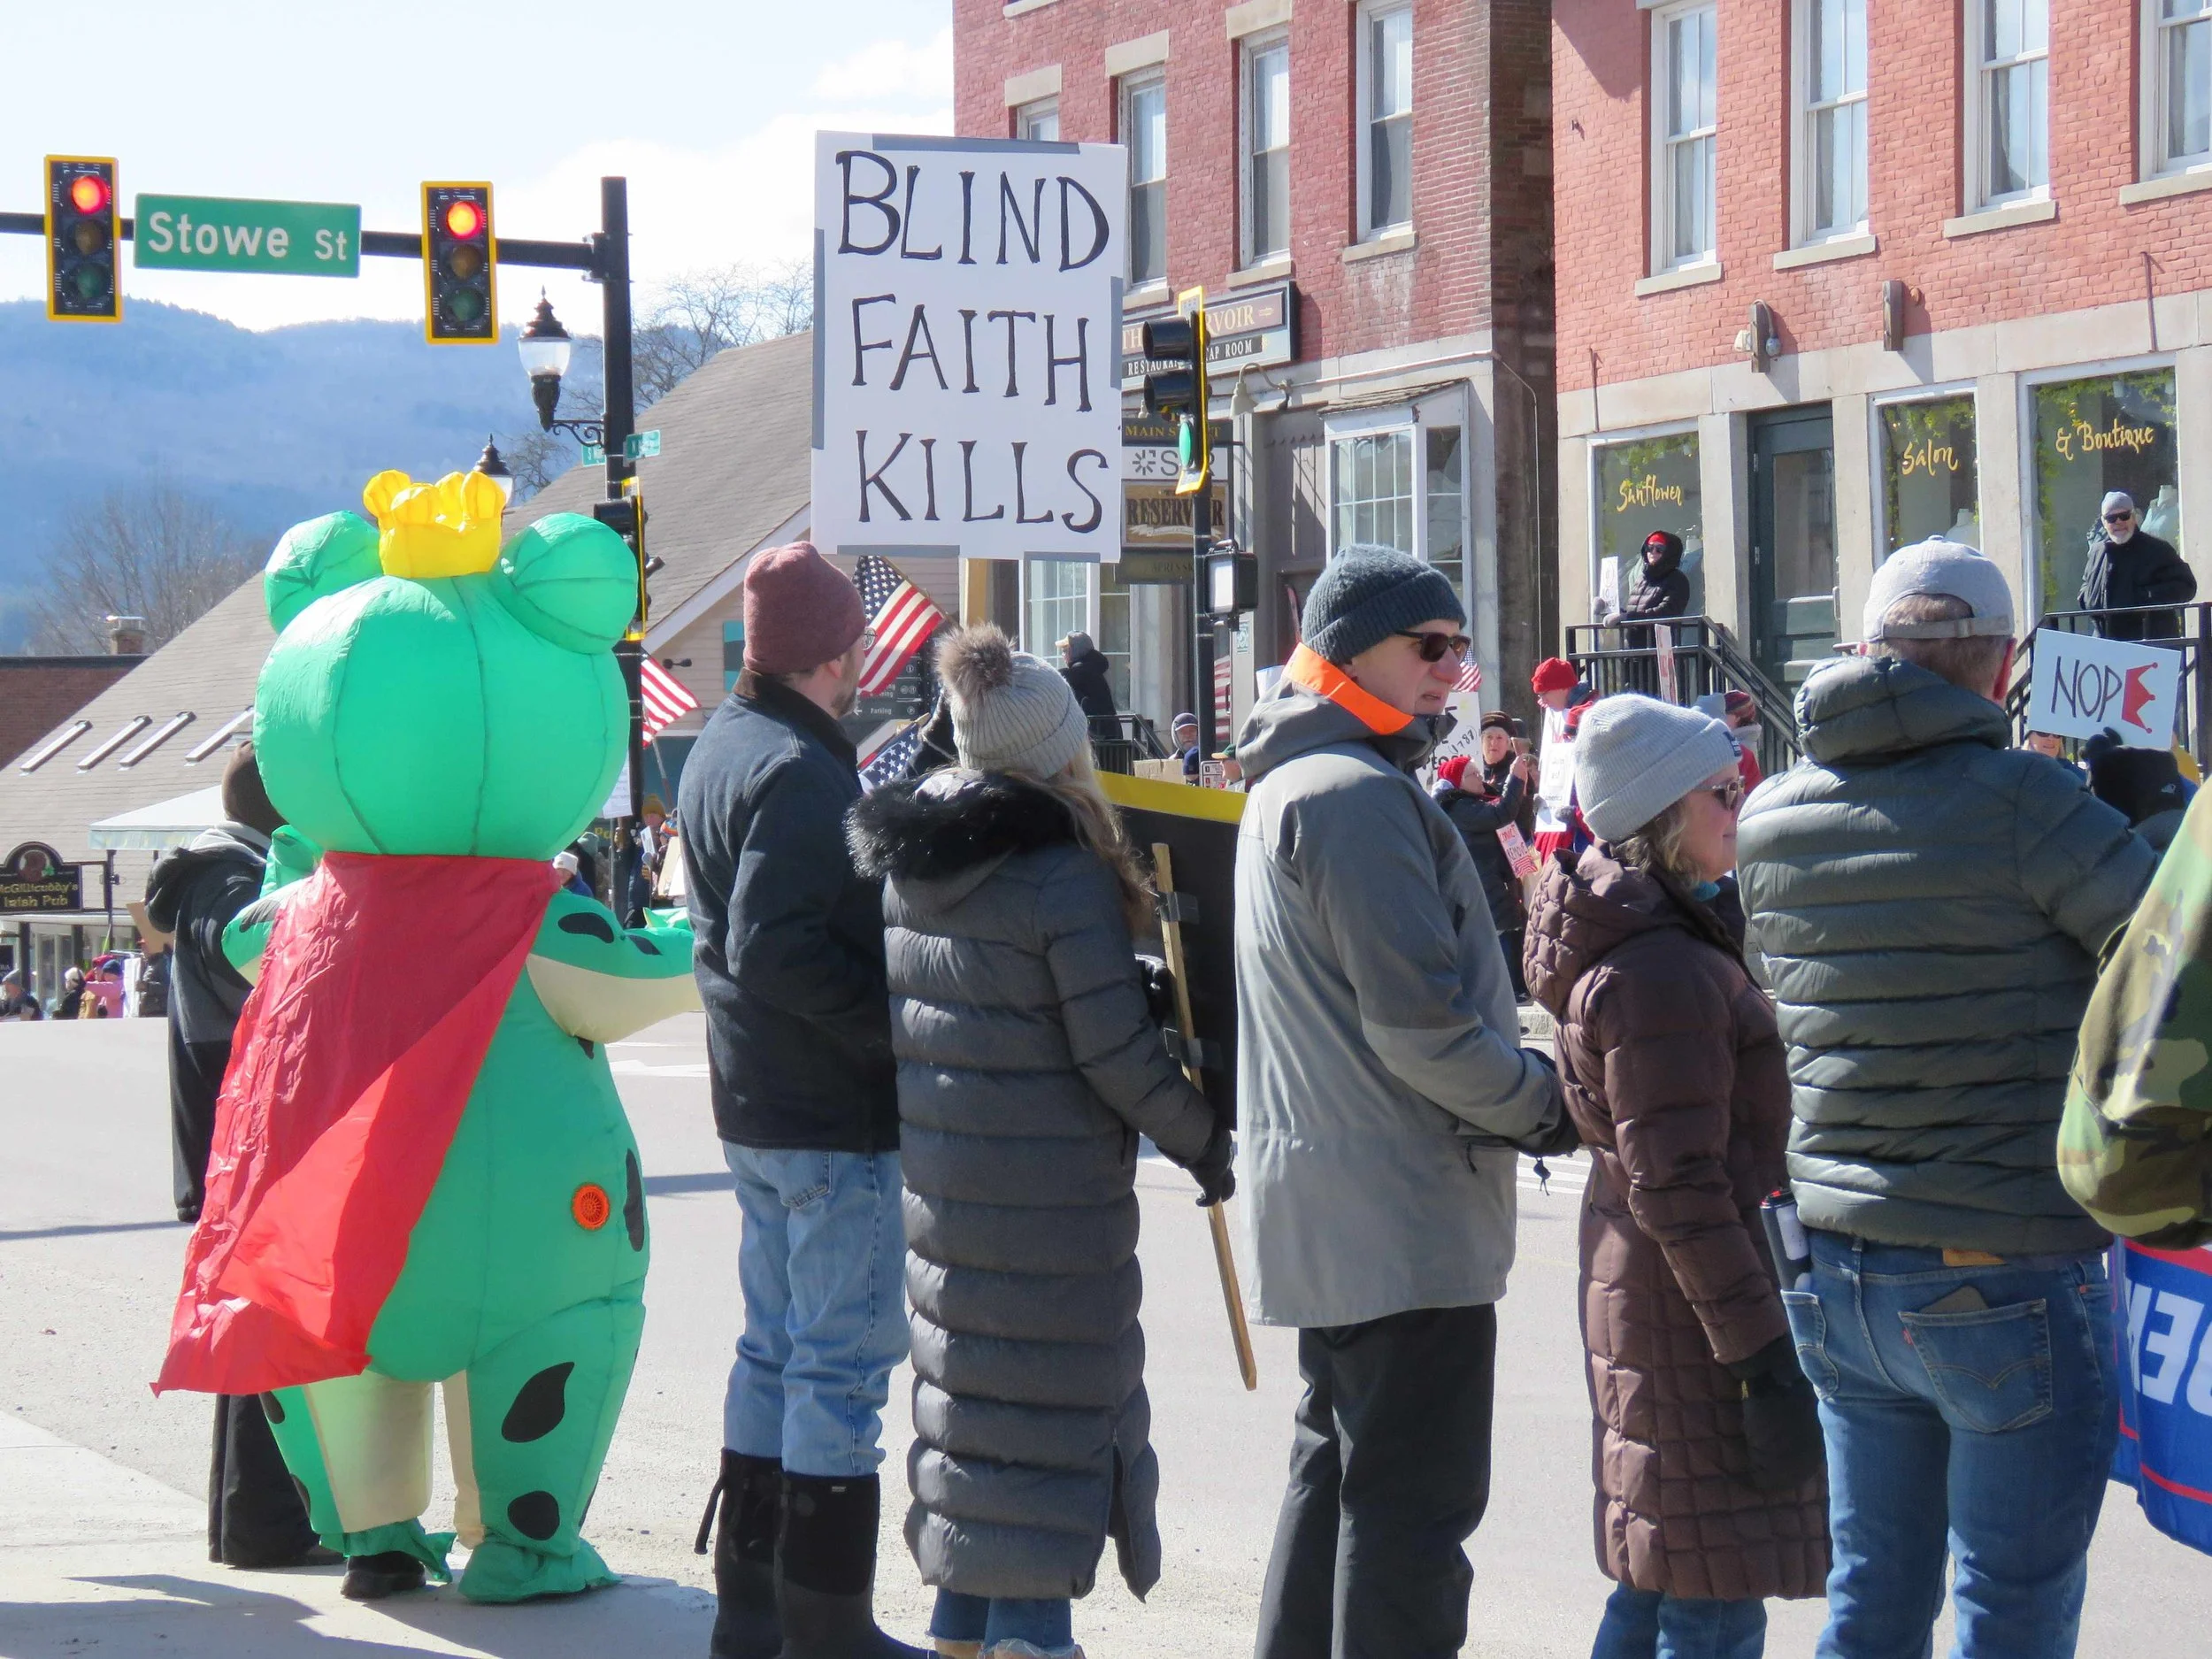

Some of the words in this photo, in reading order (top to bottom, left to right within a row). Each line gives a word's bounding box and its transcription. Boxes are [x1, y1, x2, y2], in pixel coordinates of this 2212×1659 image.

[835, 150, 1110, 273] BLIND
[148, 211, 289, 258] Stowe
[314, 228, 348, 262] St
[851, 293, 1093, 412] FAITH
[1123, 328, 1141, 349] TH
[1225, 340, 1253, 357] ROOM
[1125, 426, 1164, 437] MAIN
[2055, 426, 2074, 461] &
[2077, 418, 2154, 454] Boutique
[1902, 439, 1958, 477] Salon
[856, 429, 1110, 534] KILLS
[1617, 474, 1682, 512] Sunflower
[1126, 498, 1225, 526] RESERVR
[4, 895, 38, 908] Irish
[42, 894, 68, 906] Pub
